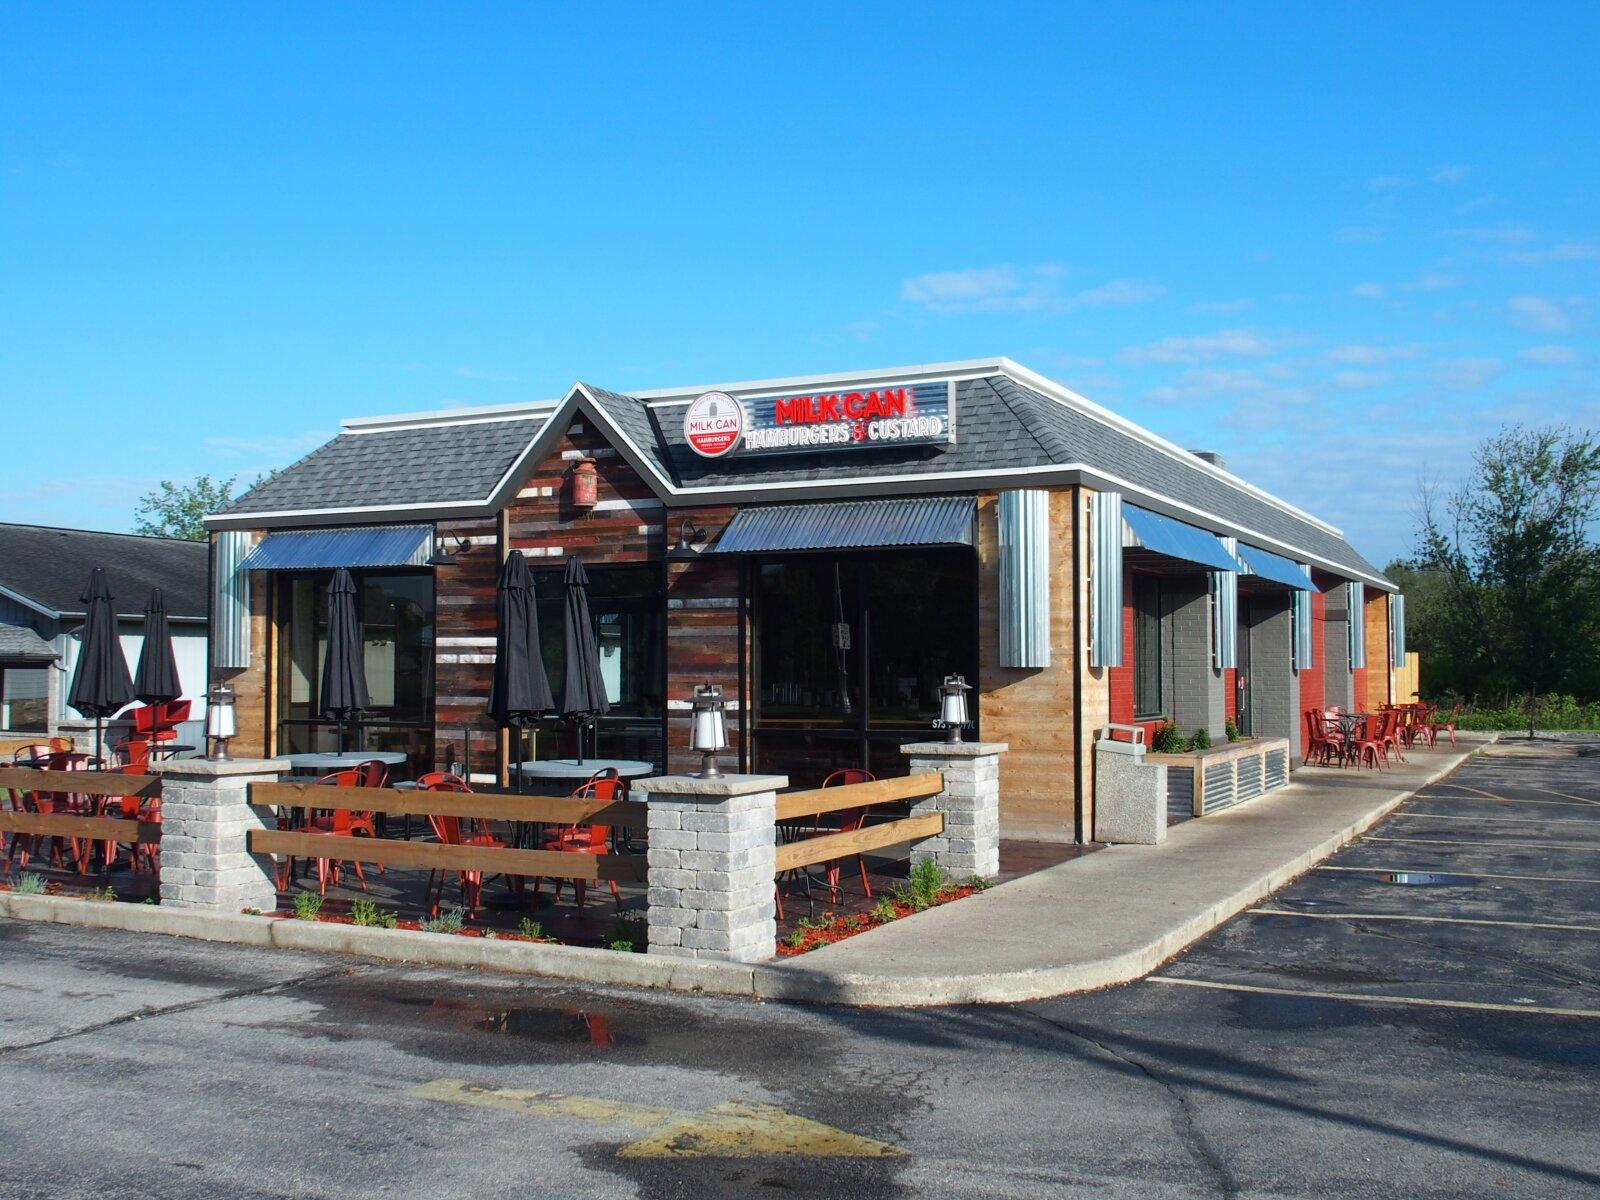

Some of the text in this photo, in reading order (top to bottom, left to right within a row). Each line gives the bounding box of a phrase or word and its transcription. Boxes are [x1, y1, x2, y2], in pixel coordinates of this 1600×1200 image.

[775, 388, 907, 425] MILK CAN
[690, 418, 737, 431] MILK CAN
[745, 416, 942, 450] HAMBURGERS & CUSTARD
